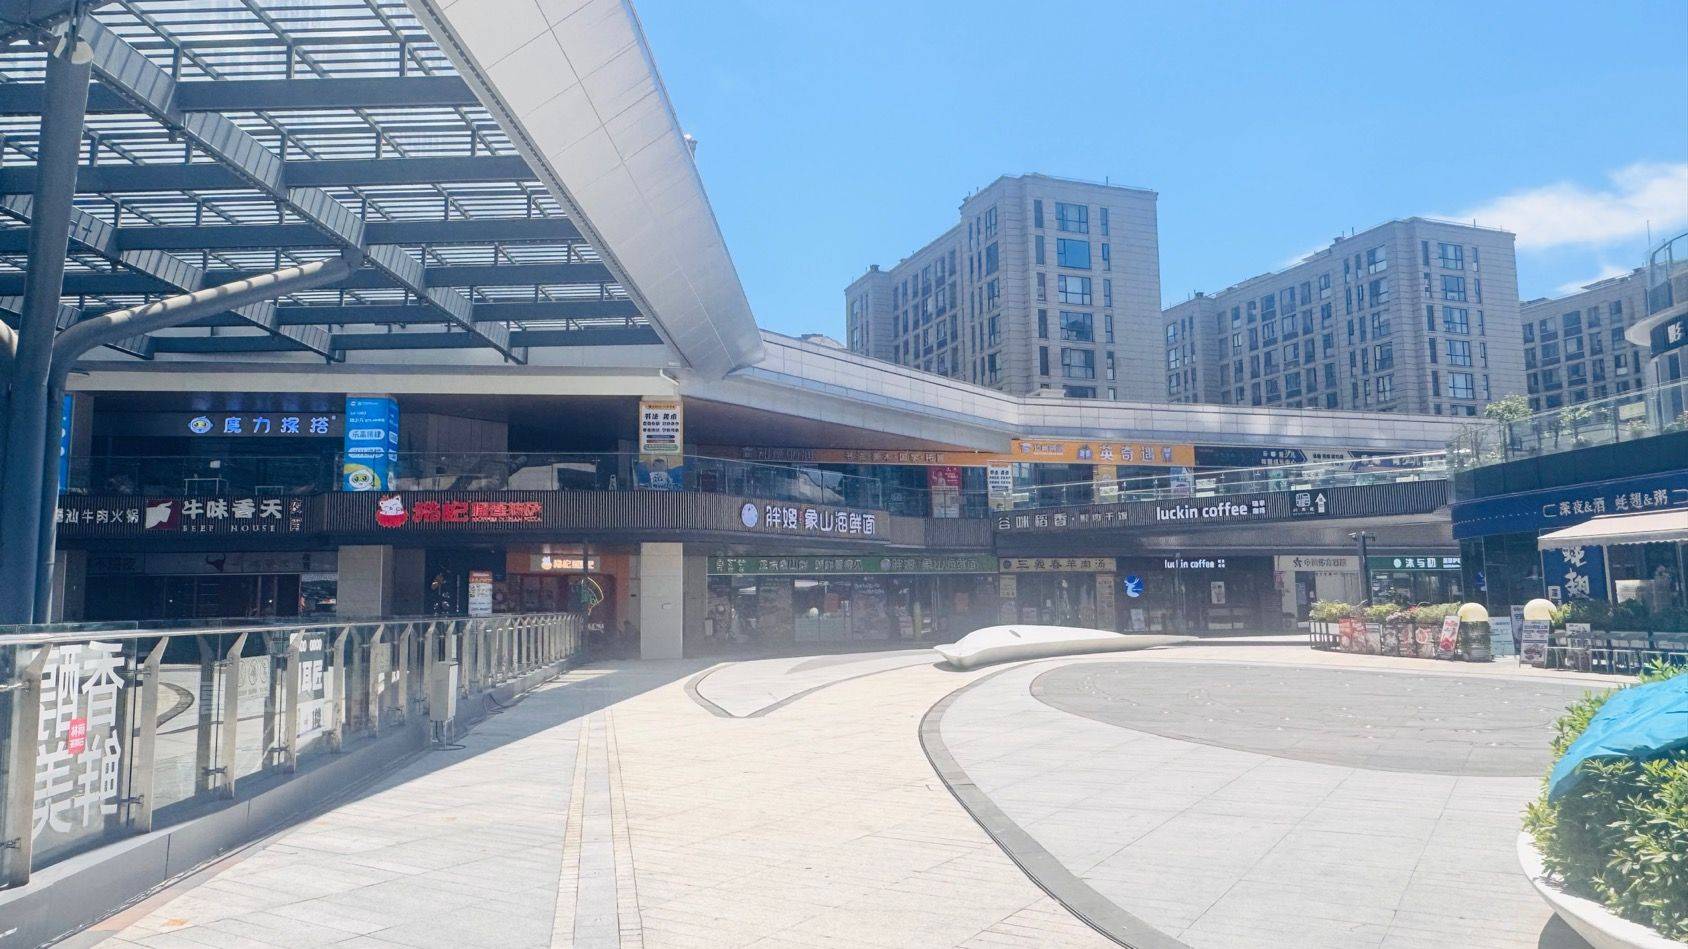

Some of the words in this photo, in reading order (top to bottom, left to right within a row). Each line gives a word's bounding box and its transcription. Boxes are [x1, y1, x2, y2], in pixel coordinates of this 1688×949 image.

[765, 505, 797, 529] 胖嫂
[804, 508, 876, 535] 象山海鲜面
[1156, 505, 1199, 521] luckin
[1202, 502, 1248, 518] coffee
[1190, 559, 1215, 569] coffee
